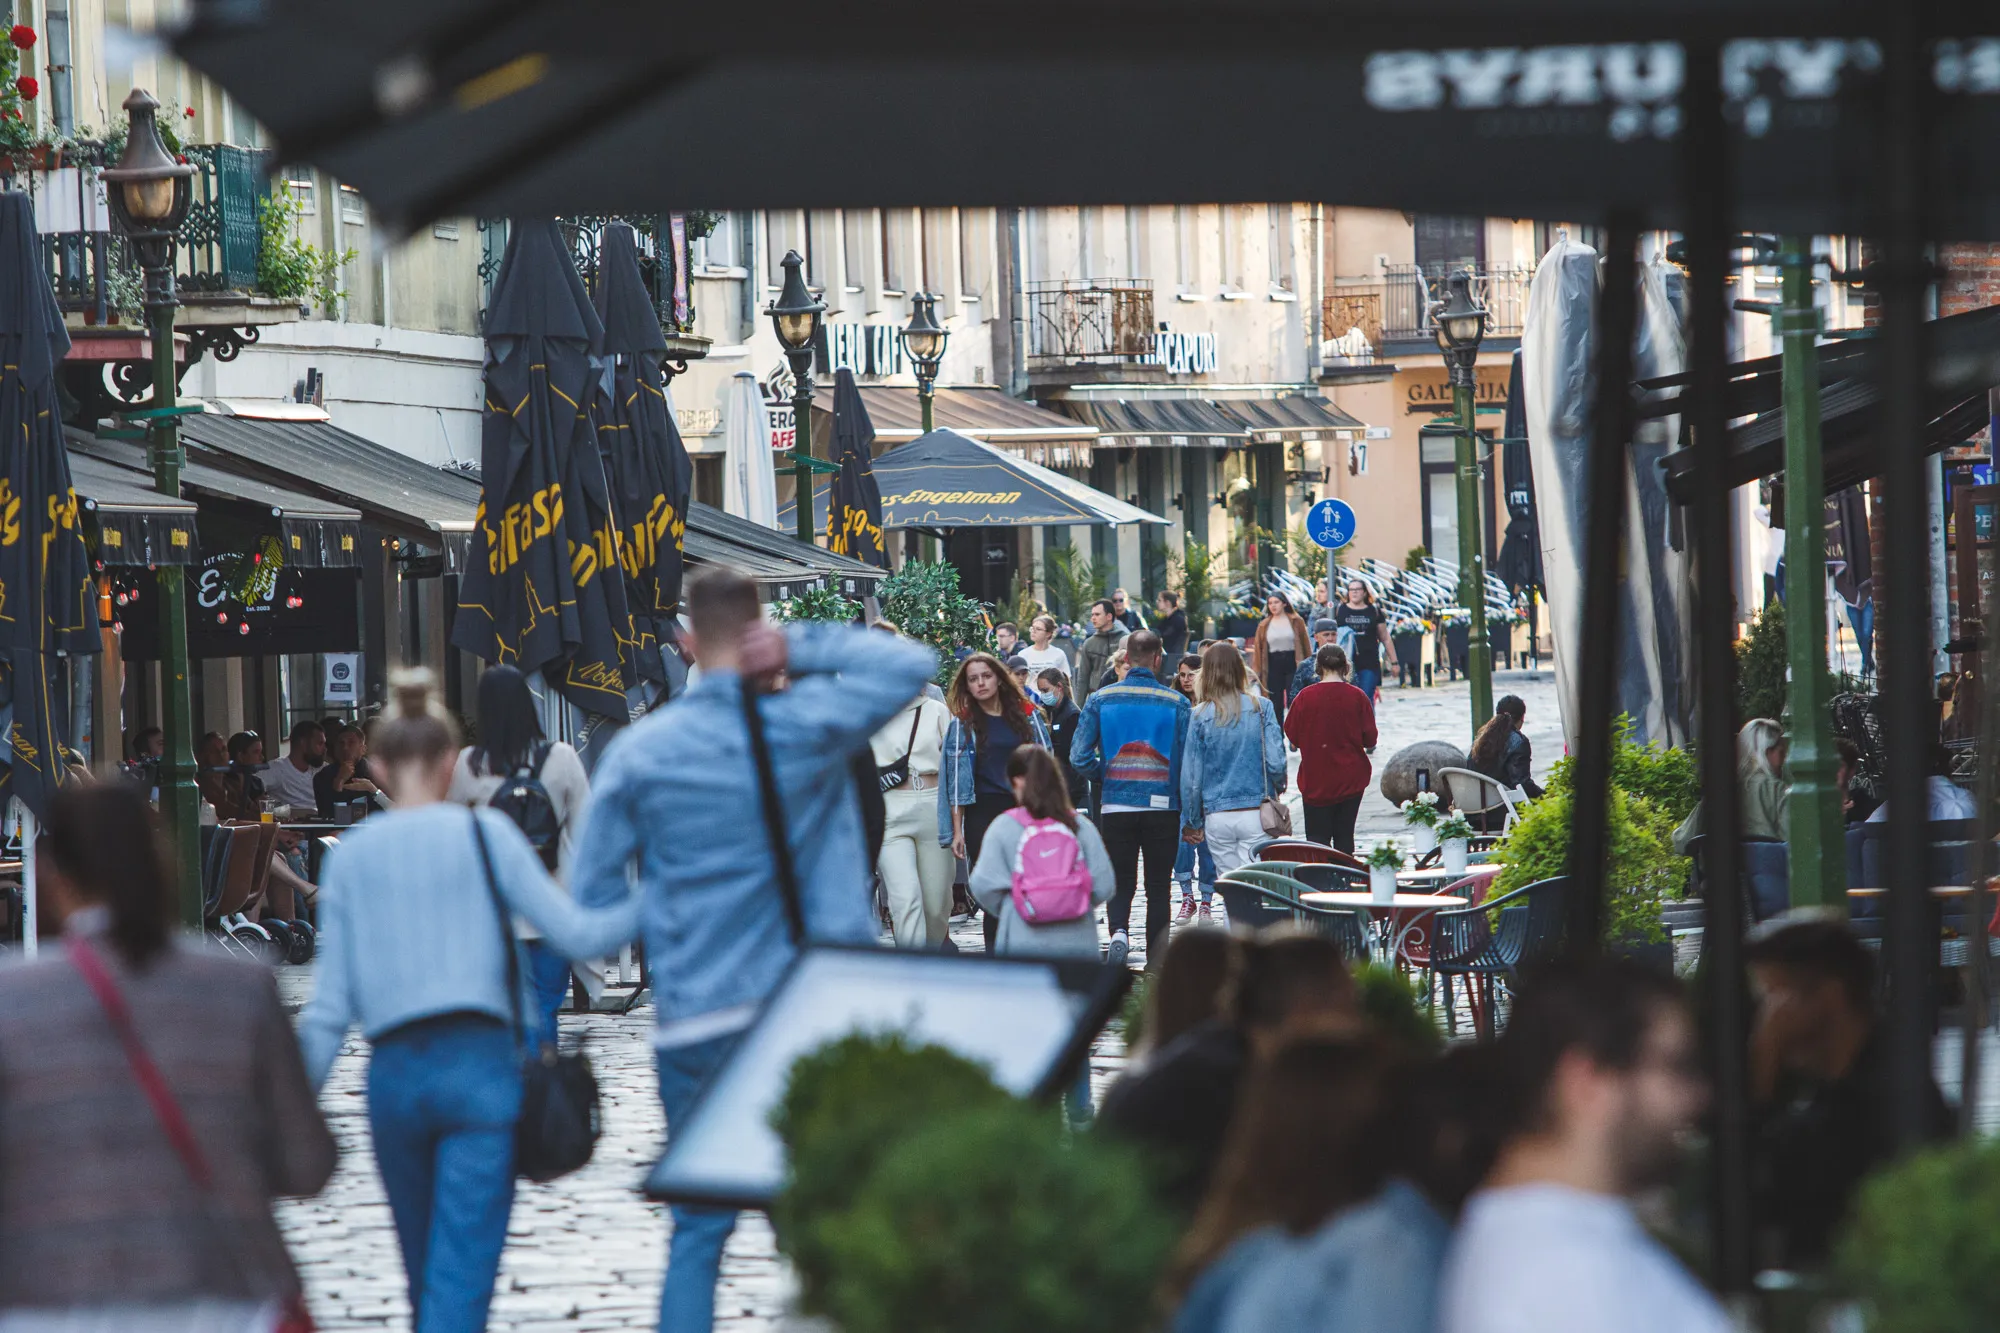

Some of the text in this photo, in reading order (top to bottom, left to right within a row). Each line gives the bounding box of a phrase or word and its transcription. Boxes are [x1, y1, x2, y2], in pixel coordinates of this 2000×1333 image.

[826, 324, 901, 375] VERO CAF
[1408, 384, 1507, 402] GALIJA
[769, 410, 796, 428] ERO
[771, 430, 797, 448] AFE
[1359, 445, 1366, 471] 7
[578, 661, 625, 690] Volfa
